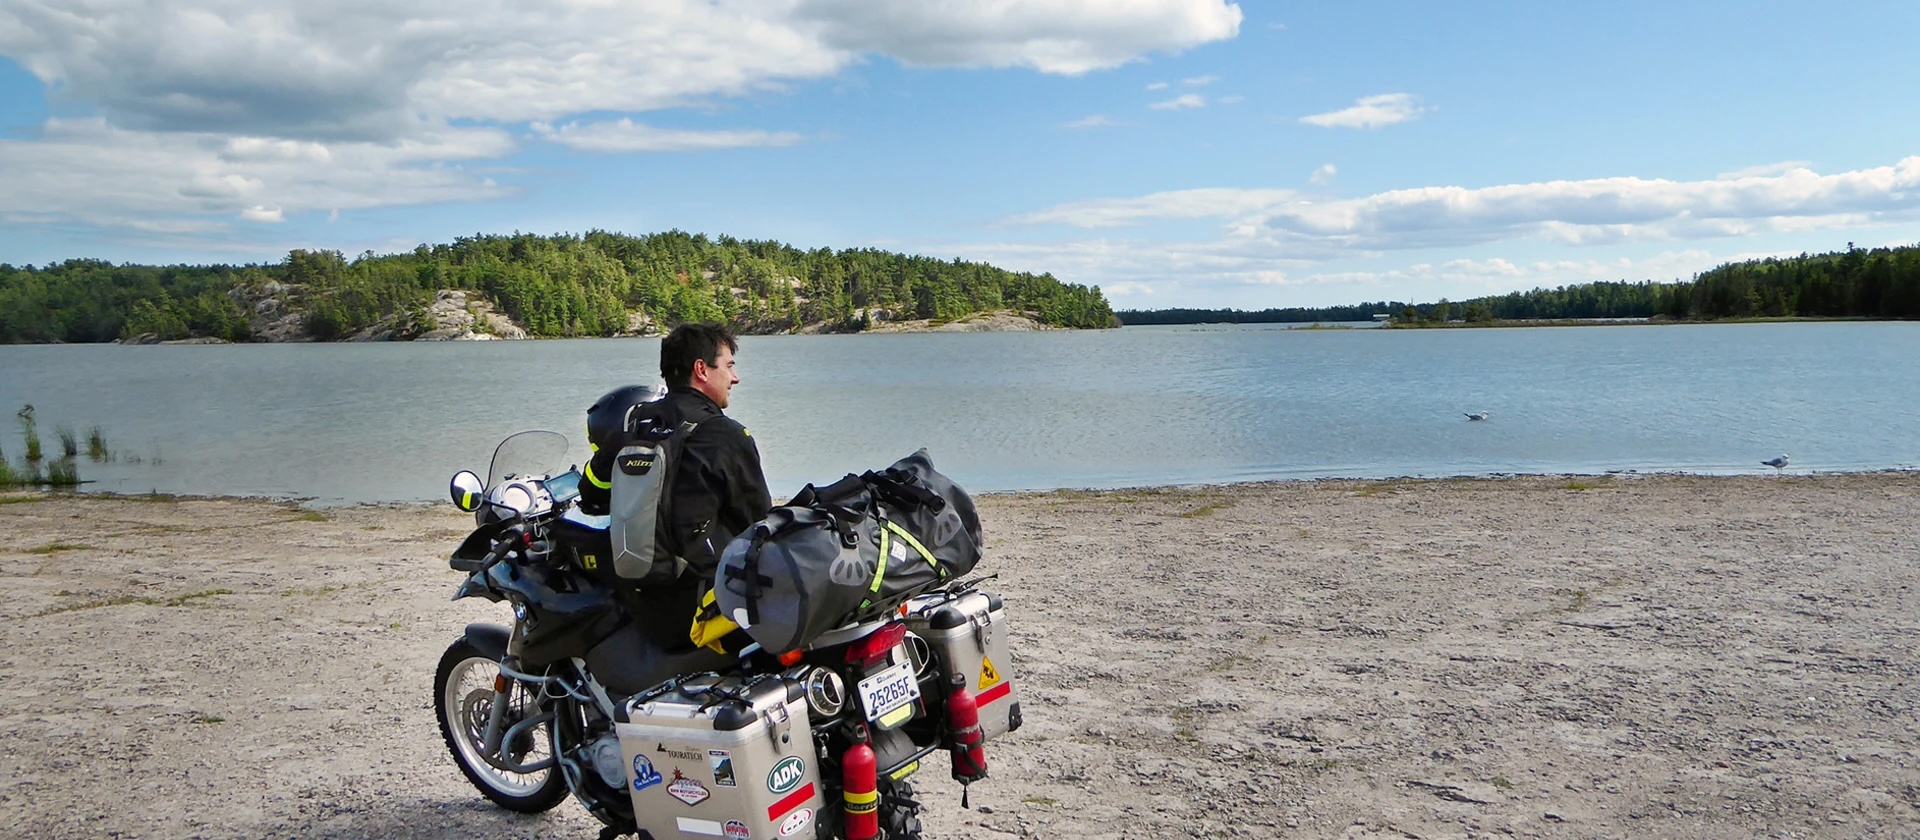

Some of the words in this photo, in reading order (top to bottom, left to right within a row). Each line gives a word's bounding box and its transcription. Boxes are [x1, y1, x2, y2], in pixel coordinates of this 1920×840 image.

[626, 459, 653, 467] Klim
[869, 675, 909, 709] 25265F
[667, 750, 703, 761] TOURATECH
[773, 759, 802, 790] ADK
